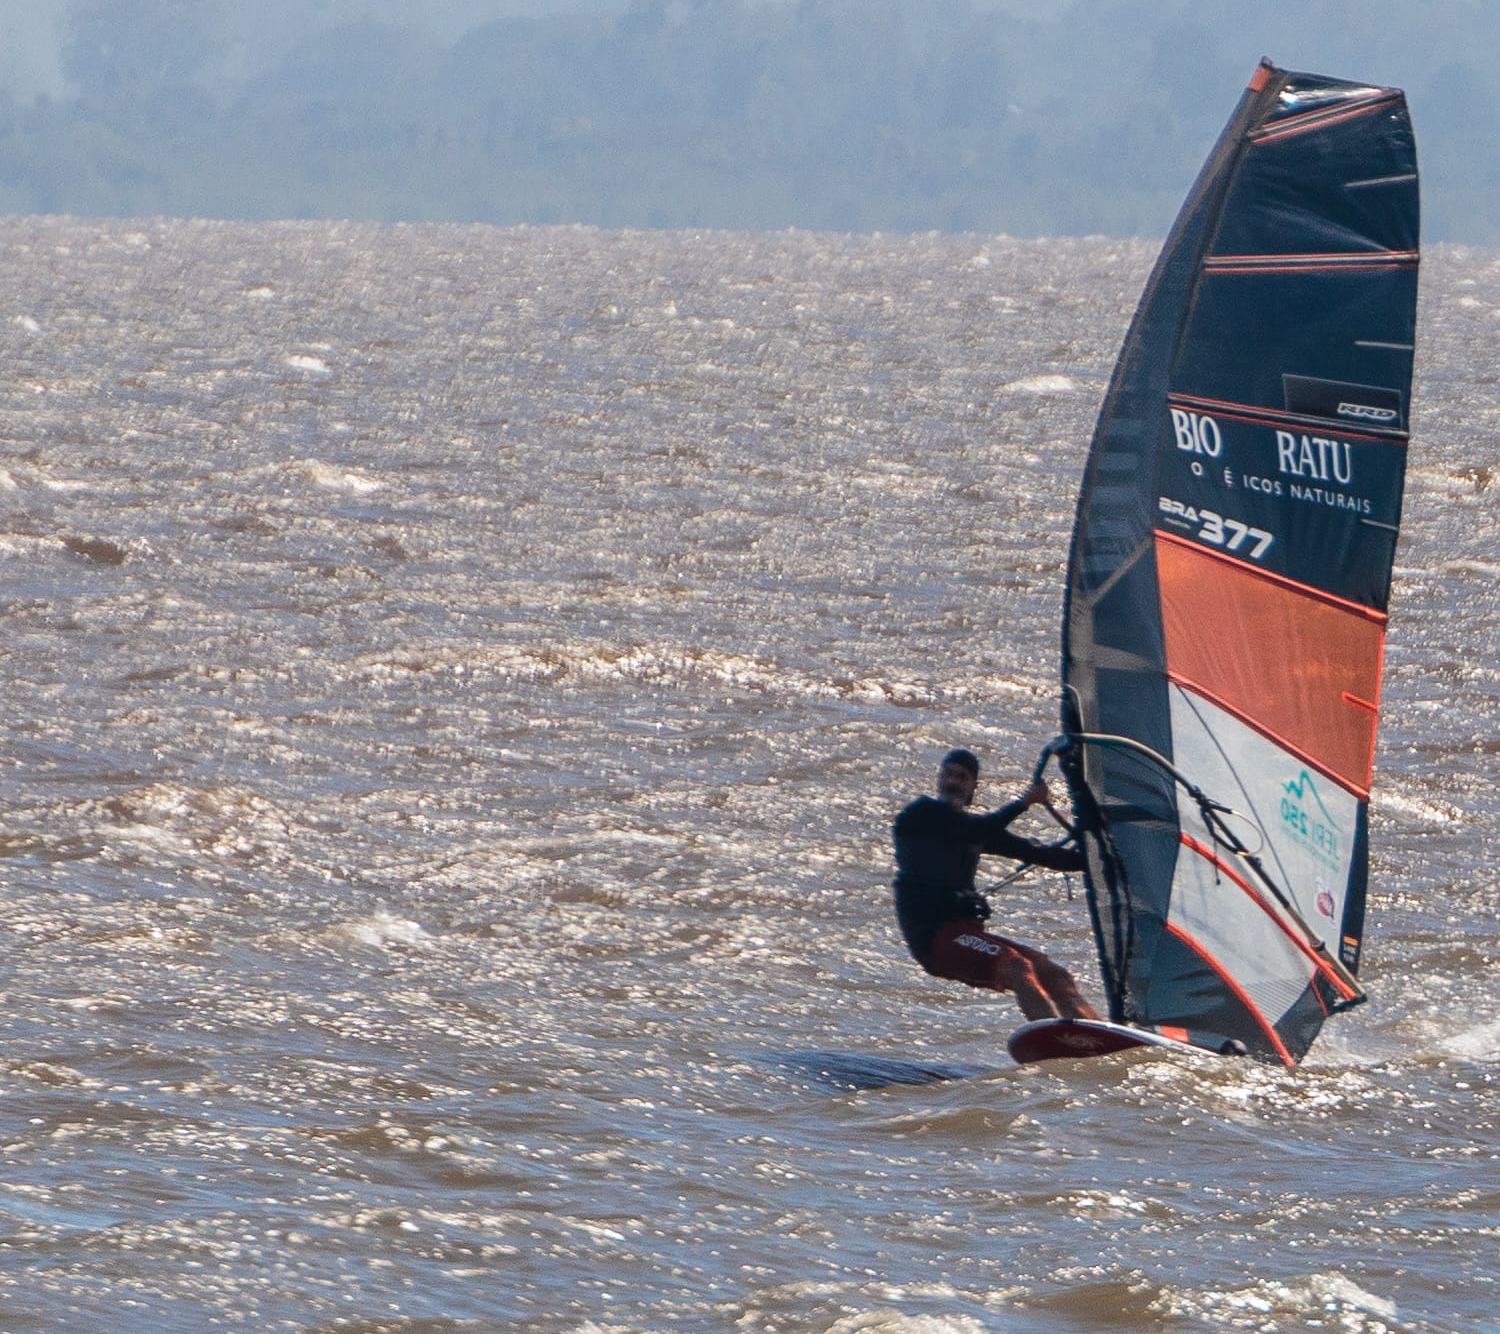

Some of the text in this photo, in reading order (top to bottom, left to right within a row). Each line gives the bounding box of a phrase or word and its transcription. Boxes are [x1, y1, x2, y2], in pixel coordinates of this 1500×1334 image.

[1170, 408, 1352, 484] BIO RATU
[1159, 497, 1274, 559] BRA 377
[1290, 484, 1371, 514] NATURAIS
